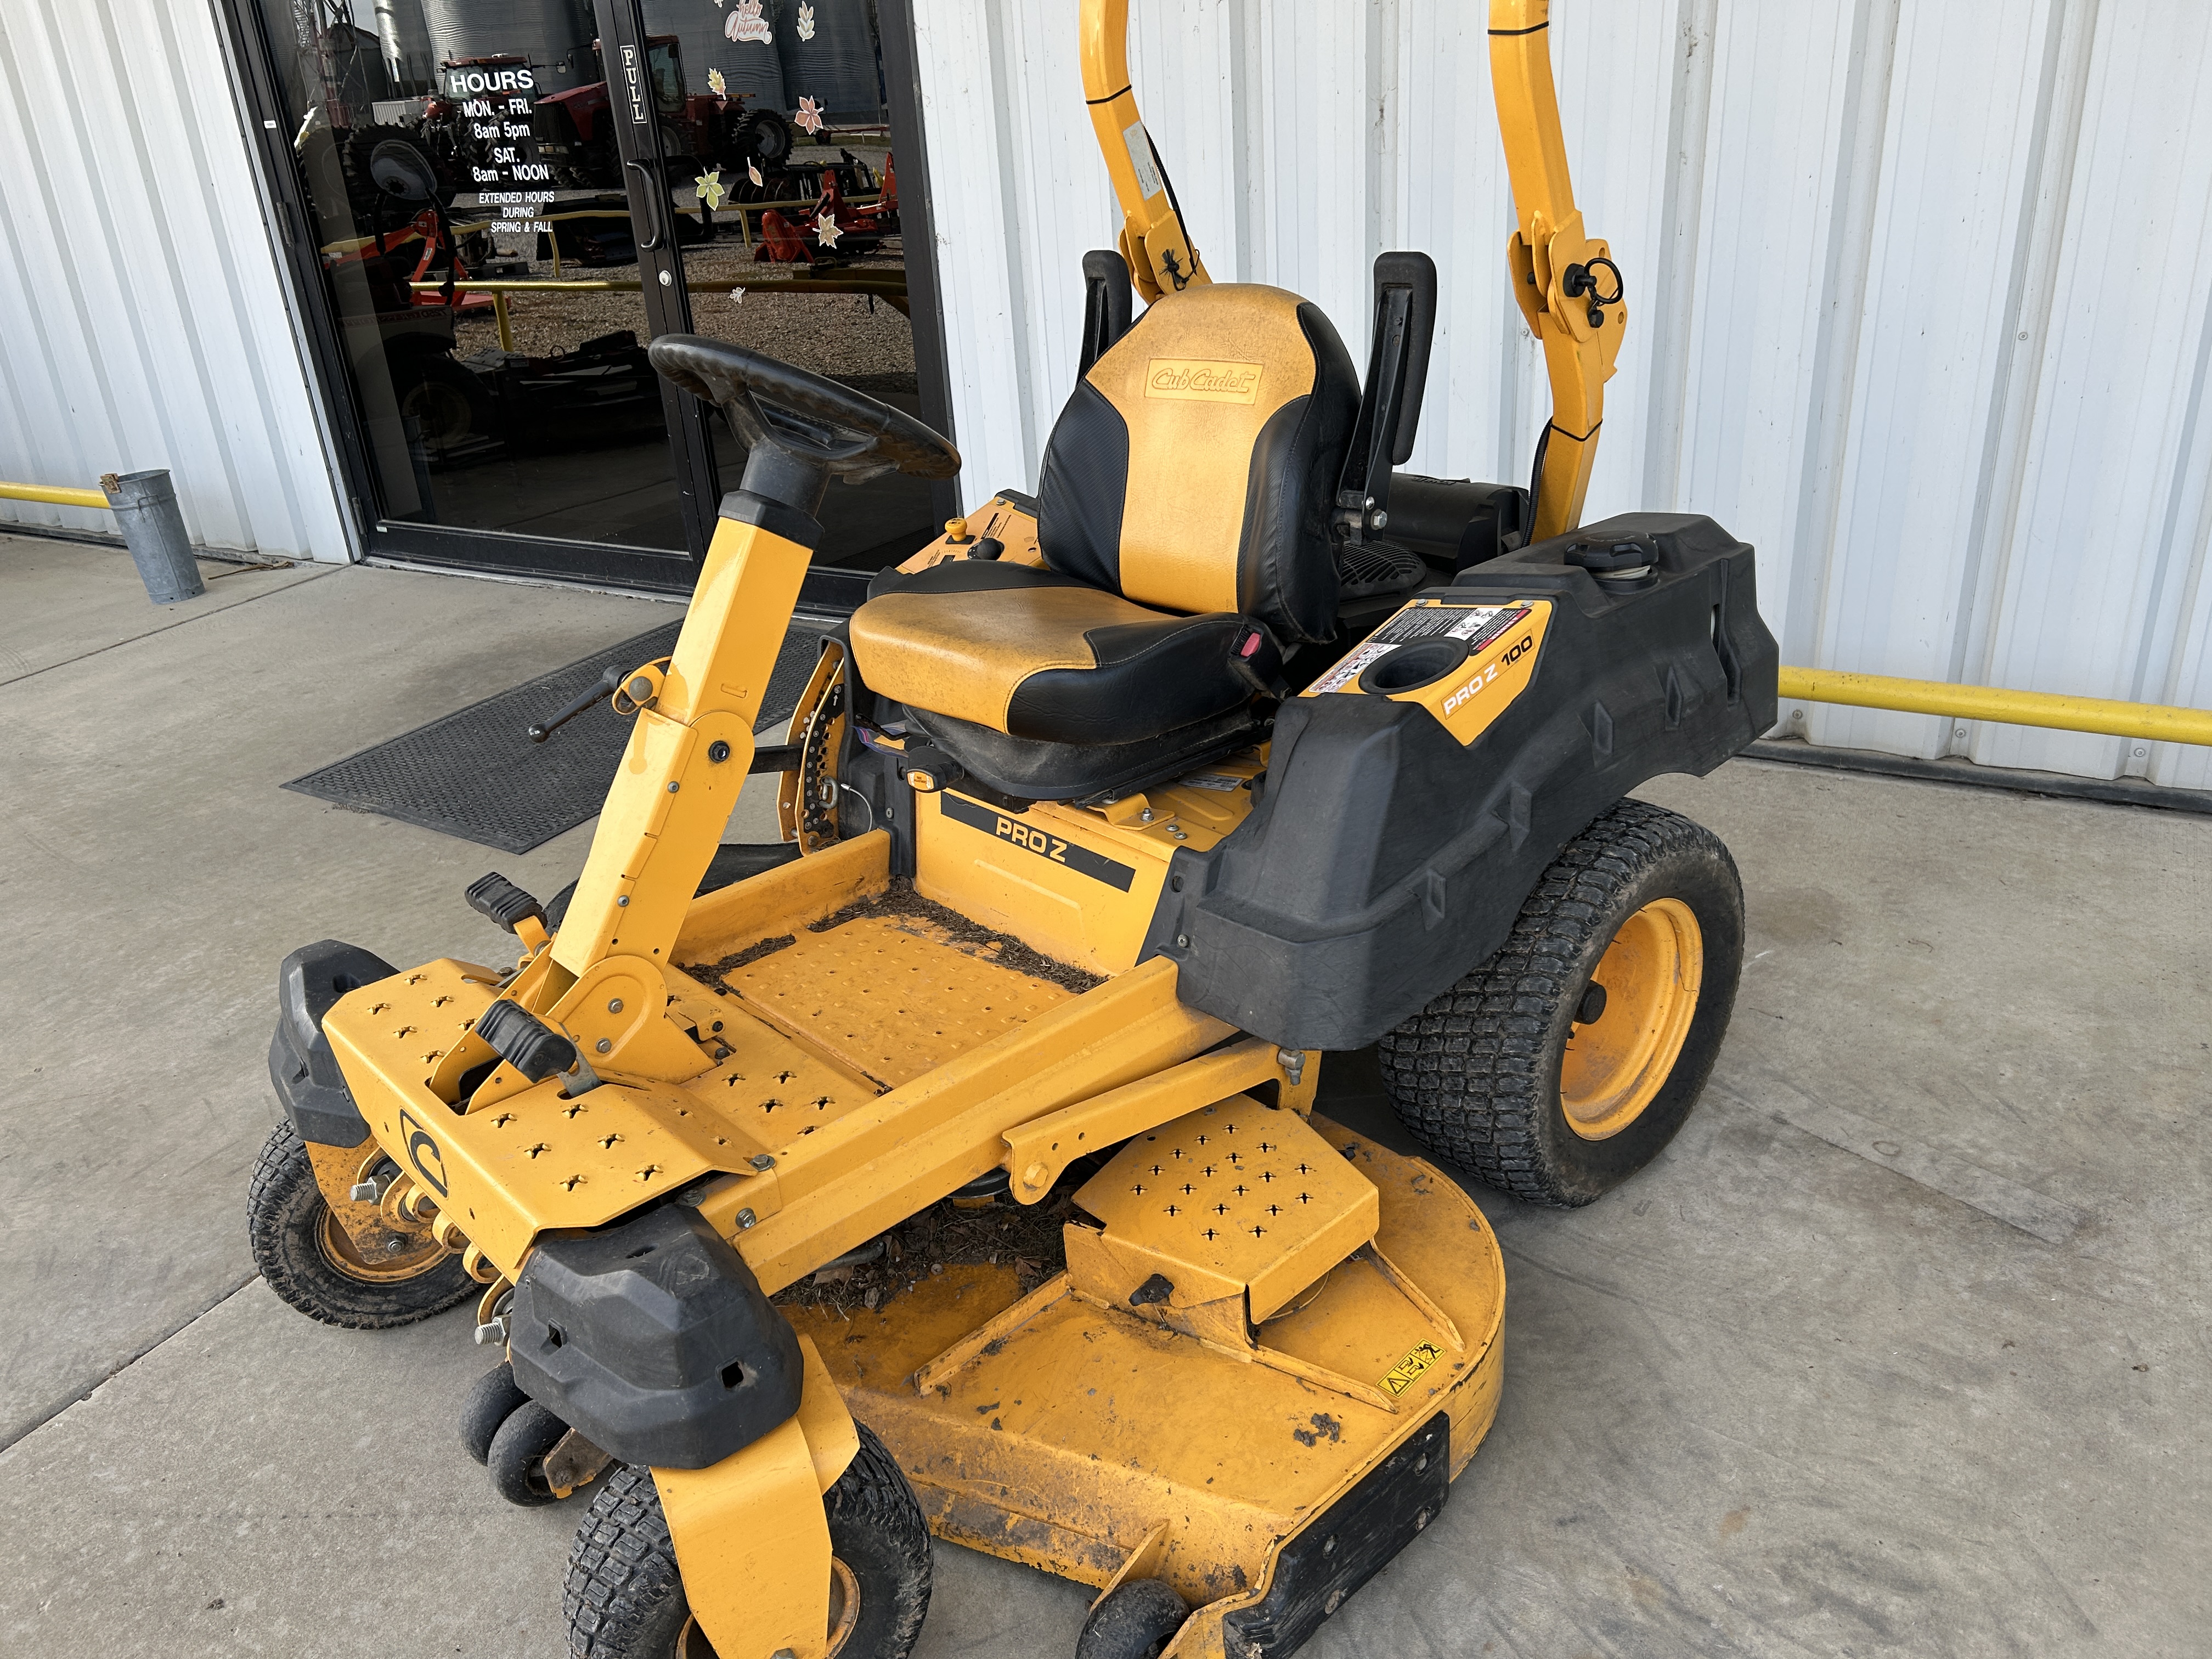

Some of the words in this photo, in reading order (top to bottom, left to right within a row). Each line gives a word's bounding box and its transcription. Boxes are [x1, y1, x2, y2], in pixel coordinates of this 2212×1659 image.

[739, 0, 761, 18] hello
[450, 70, 534, 93] HOURS
[623, 49, 644, 120] PULL
[462, 99, 495, 117] MON.
[509, 98, 532, 115] FRI.
[473, 123, 500, 139] 8am
[503, 121, 531, 140] 5pm
[494, 147, 520, 163] SAT.
[472, 166, 499, 182] 8am
[512, 164, 550, 180] NOON
[479, 193, 522, 204] EXTENDED
[525, 191, 555, 203] HOURS
[503, 206, 534, 218] DURING
[491, 222, 521, 233] SPRING
[524, 222, 530, 233] &
[533, 221, 553, 232] FALL
[1152, 368, 1189, 390] Cub
[1190, 369, 1256, 393] Cadet
[1443, 676, 1483, 715] PRO
[1486, 663, 1498, 682] Z
[1501, 635, 1533, 666] 100
[996, 816, 1047, 853] PRO
[1049, 841, 1068, 862] Z
